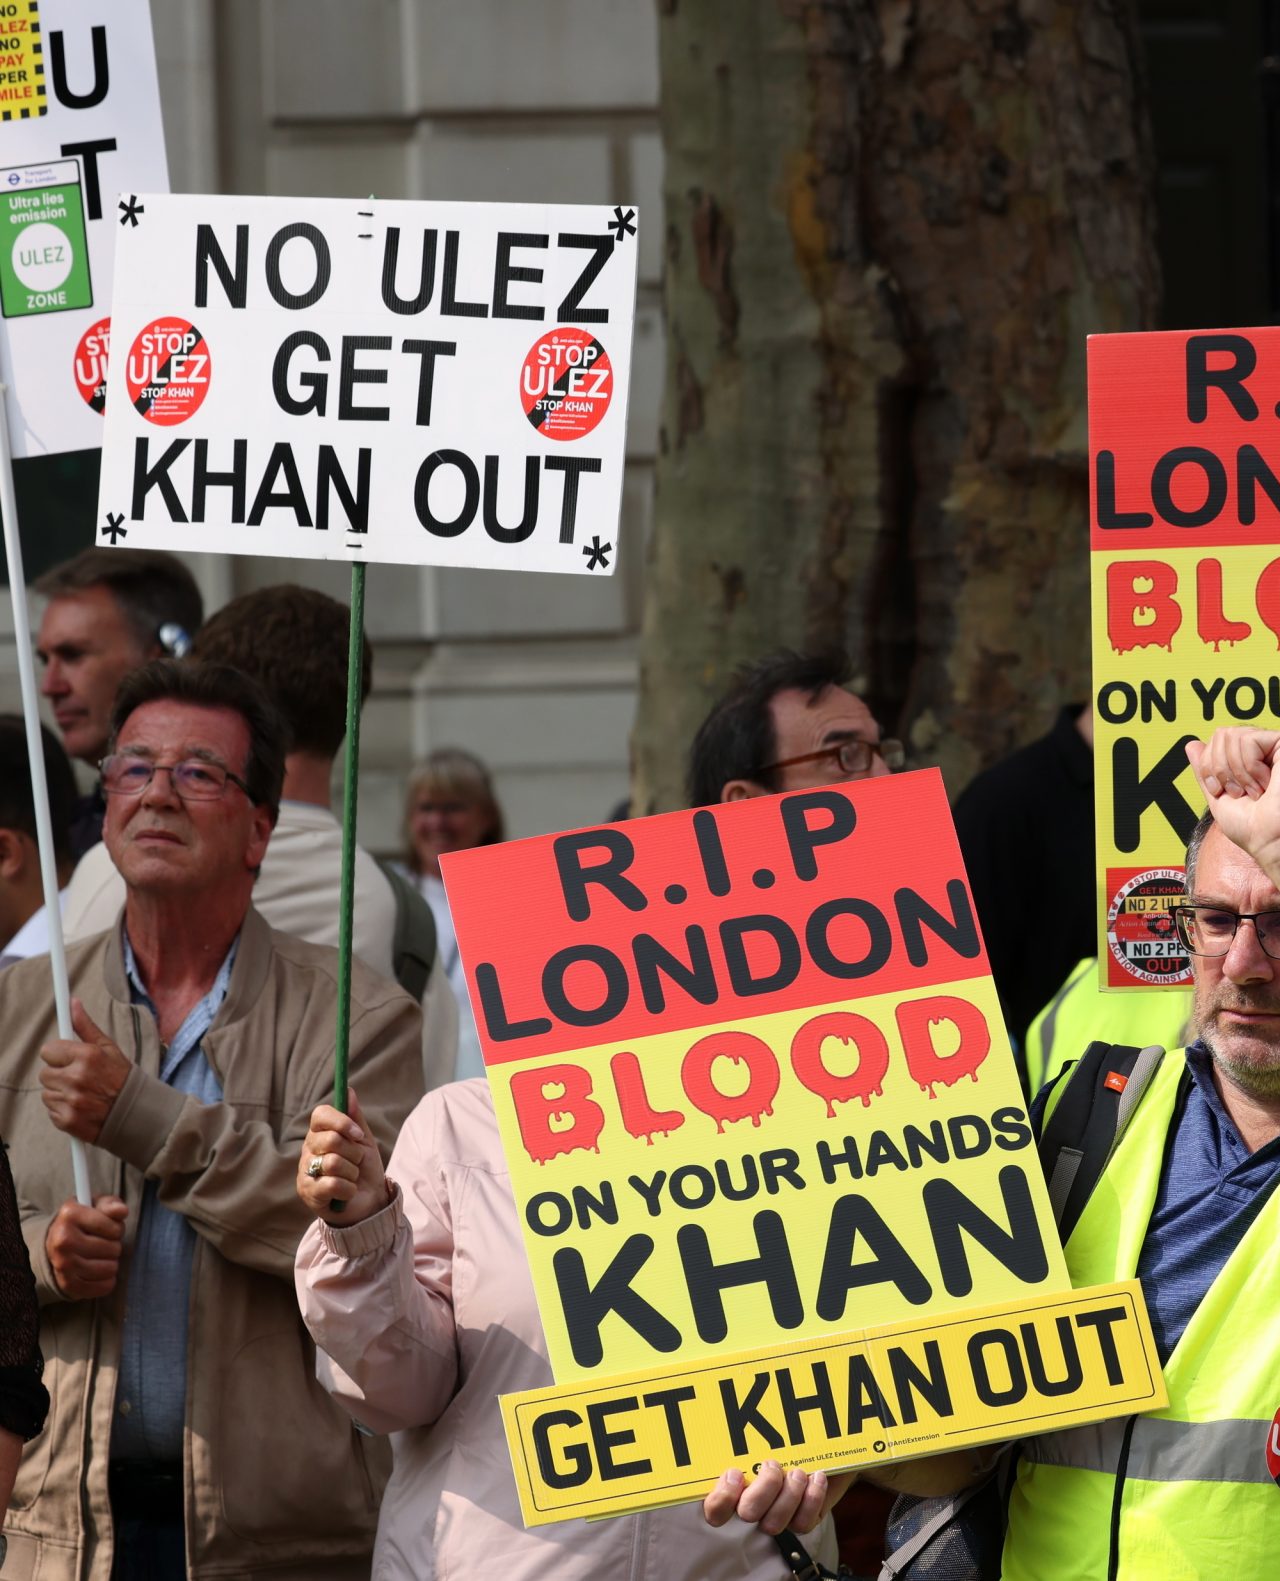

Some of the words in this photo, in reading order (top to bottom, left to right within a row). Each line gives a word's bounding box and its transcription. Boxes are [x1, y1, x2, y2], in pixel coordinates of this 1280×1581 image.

[0, 19, 28, 34] LEZ
[9, 195, 40, 210] Ultra
[43, 191, 65, 204] lies
[10, 207, 67, 224] emission
[20, 245, 65, 267] ULEZ
[196, 223, 330, 310] NO
[382, 227, 615, 323] ULEZ
[27, 292, 67, 309] ZONE
[85, 333, 110, 356] ST
[141, 333, 196, 354] STOP
[538, 344, 598, 366] STOP
[129, 354, 208, 384] ULEZ
[273, 331, 456, 426] GET
[141, 387, 167, 398] STOP
[168, 387, 194, 397] KHAN
[524, 365, 609, 398] ULEZ
[535, 399, 564, 411] STOP
[565, 402, 594, 413] KHAN
[132, 438, 371, 533] KHAN
[415, 449, 601, 544] OUT
[1098, 680, 1177, 724] ON
[552, 791, 857, 922] R.I.P
[1134, 871, 1160, 885] STOP
[1140, 887, 1157, 895] GET
[1129, 898, 1146, 911] NO
[1150, 898, 1158, 911] 2
[474, 878, 982, 1042] LONDON
[1133, 943, 1152, 957] NO
[1155, 942, 1164, 956] 2
[1167, 942, 1189, 956] PP
[1110, 941, 1139, 976] ACTION
[1139, 972, 1182, 984] AGAINST
[1146, 959, 1183, 972] OUT
[509, 995, 992, 1167] BLOOD
[525, 1181, 618, 1237] ON
[628, 1148, 807, 1217] YOUR
[816, 1106, 1032, 1185] HANDS
[552, 1164, 1049, 1368] KHAN
[532, 1385, 695, 1490] GET
[718, 1340, 954, 1457] KHAN
[966, 1306, 1128, 1408] OUT
[789, 1455, 815, 1467] Against
[816, 1452, 834, 1461] ULEZ
[834, 1446, 868, 1457] Extension
[888, 1433, 940, 1448] @AntiExtension
